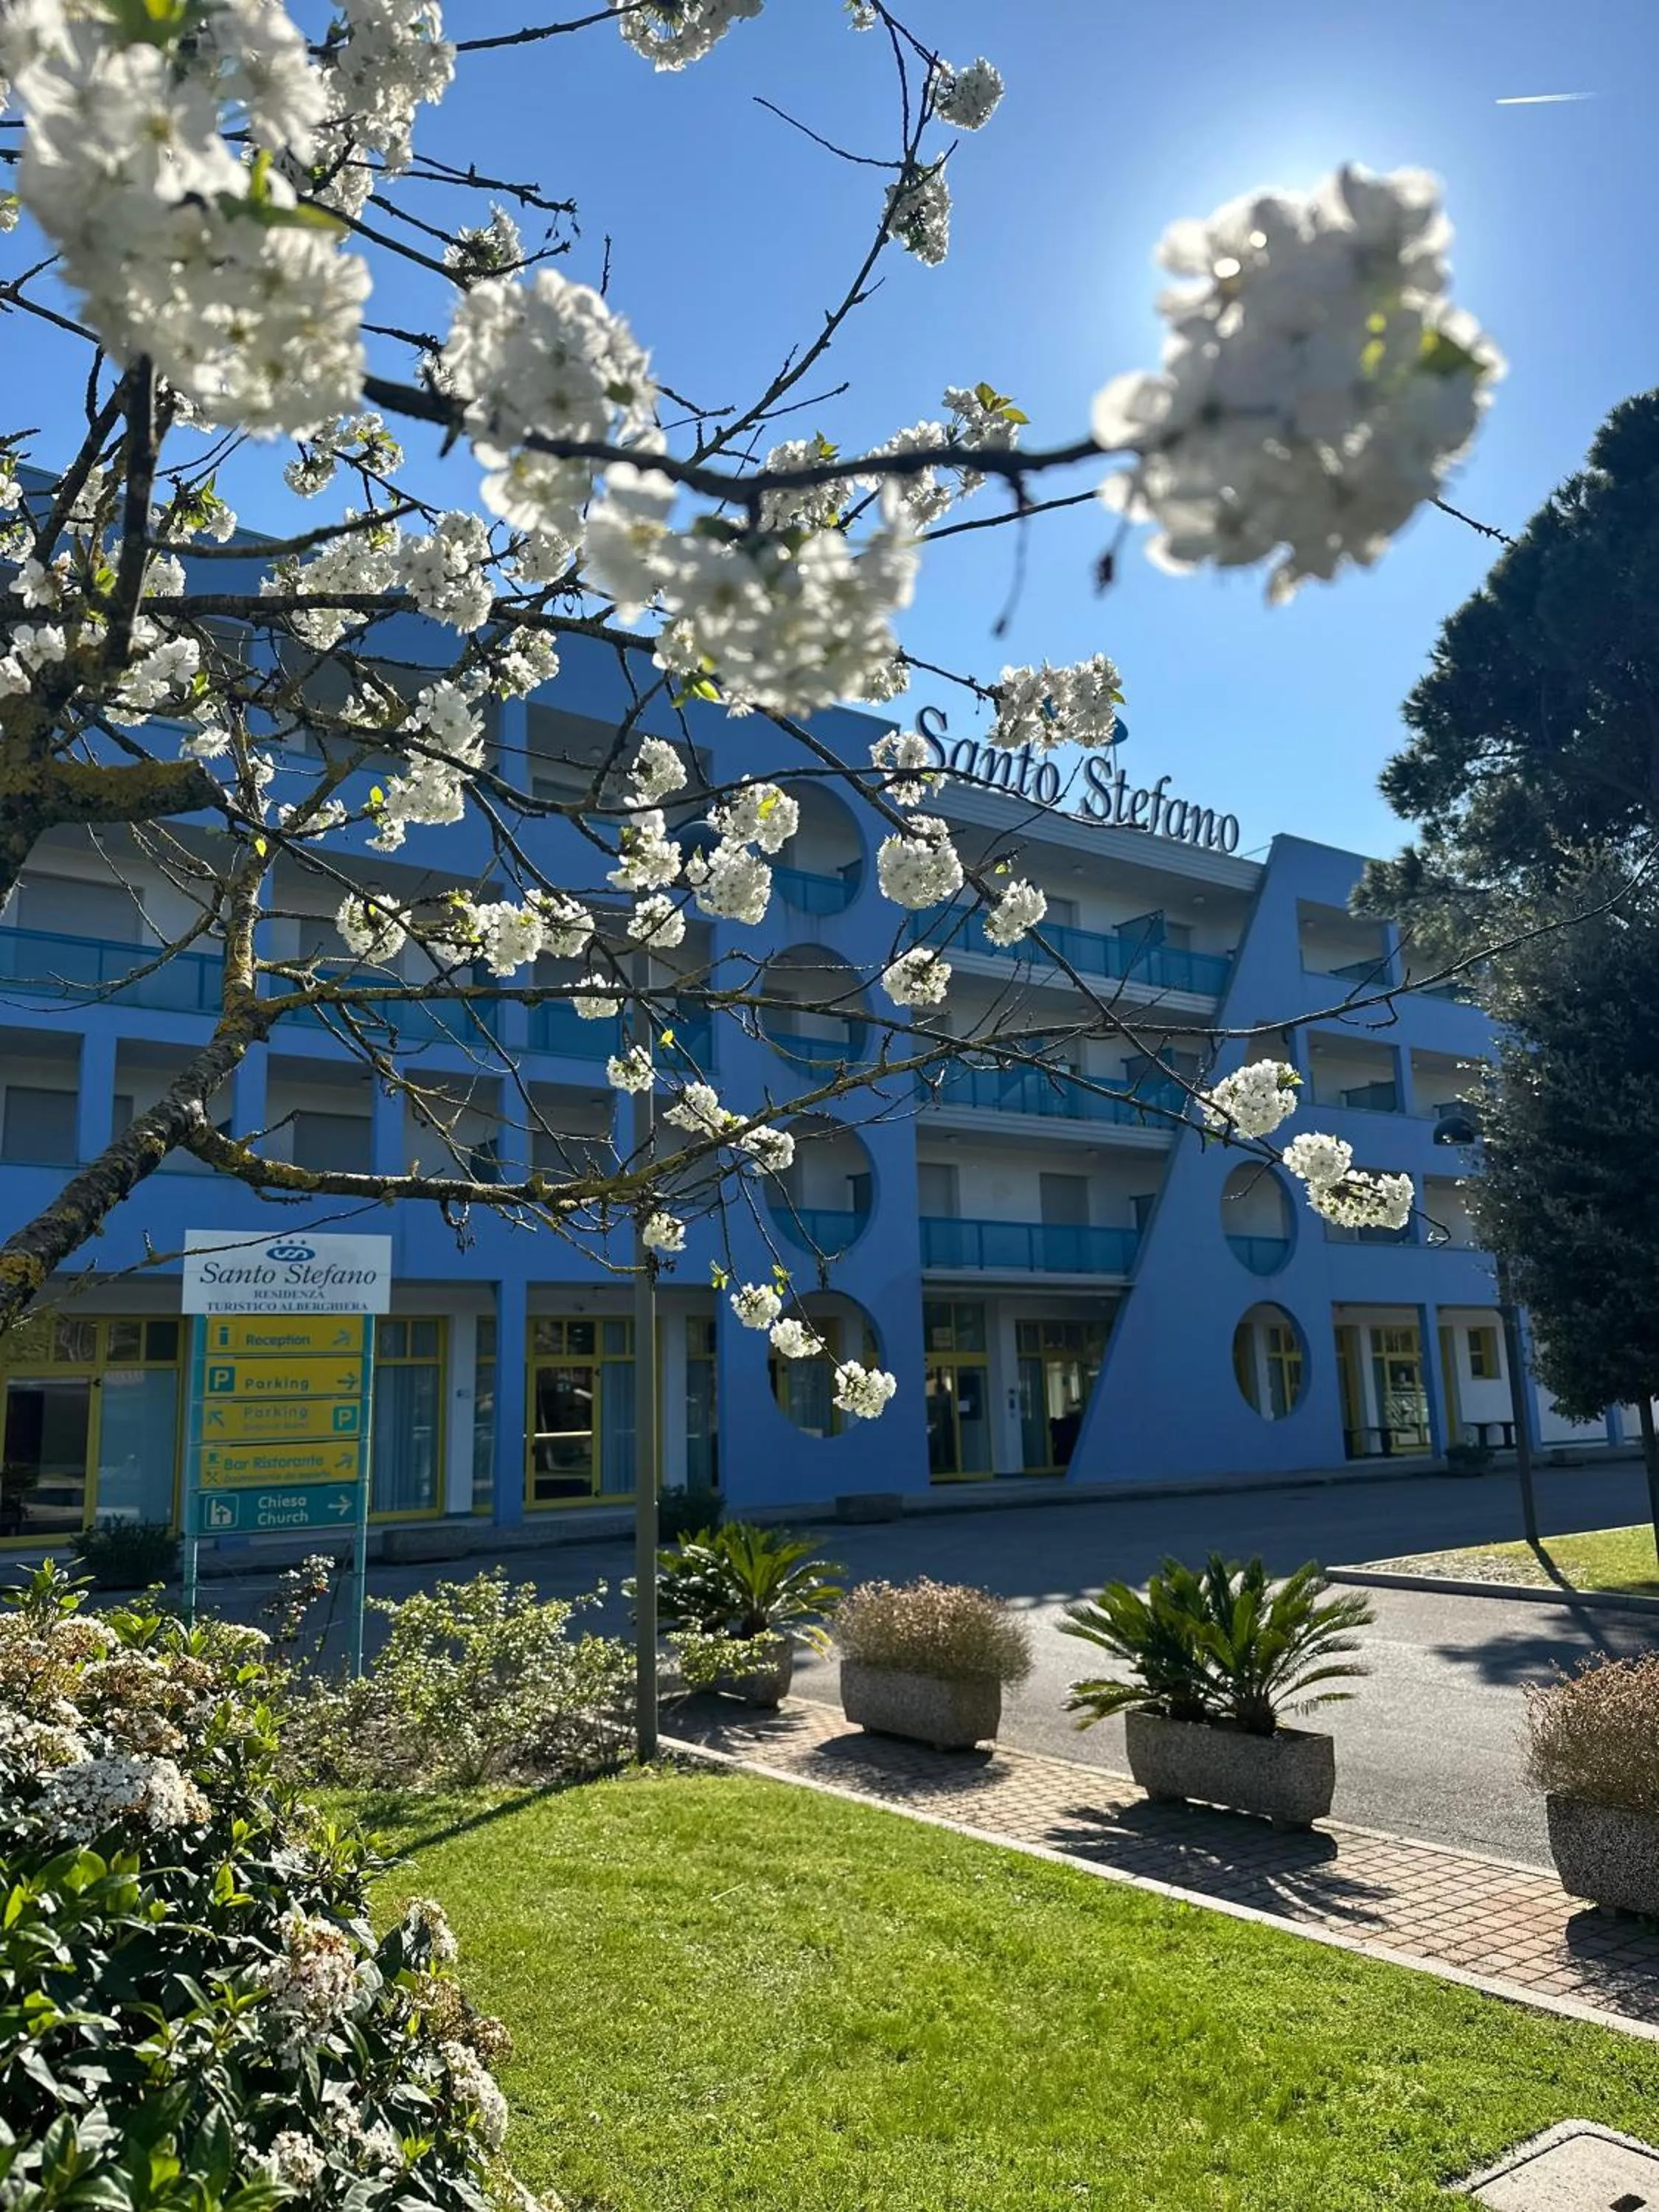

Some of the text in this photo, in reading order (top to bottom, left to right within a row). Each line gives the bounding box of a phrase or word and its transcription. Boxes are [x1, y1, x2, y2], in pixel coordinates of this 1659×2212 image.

[916, 706, 1240, 853] Santo Stefano
[200, 1262, 377, 1289] Santo Stefano
[254, 1290, 324, 1299] RESIDENZA
[207, 1301, 368, 1311] TURISTICO ALBERGHIERA
[246, 1333, 310, 1347] Reception
[245, 1377, 309, 1391] Parking
[244, 1407, 308, 1418] Parking
[224, 1455, 324, 1470] Bar Ristorante
[259, 1495, 307, 1509] Chiesa
[258, 1512, 309, 1526] Church
